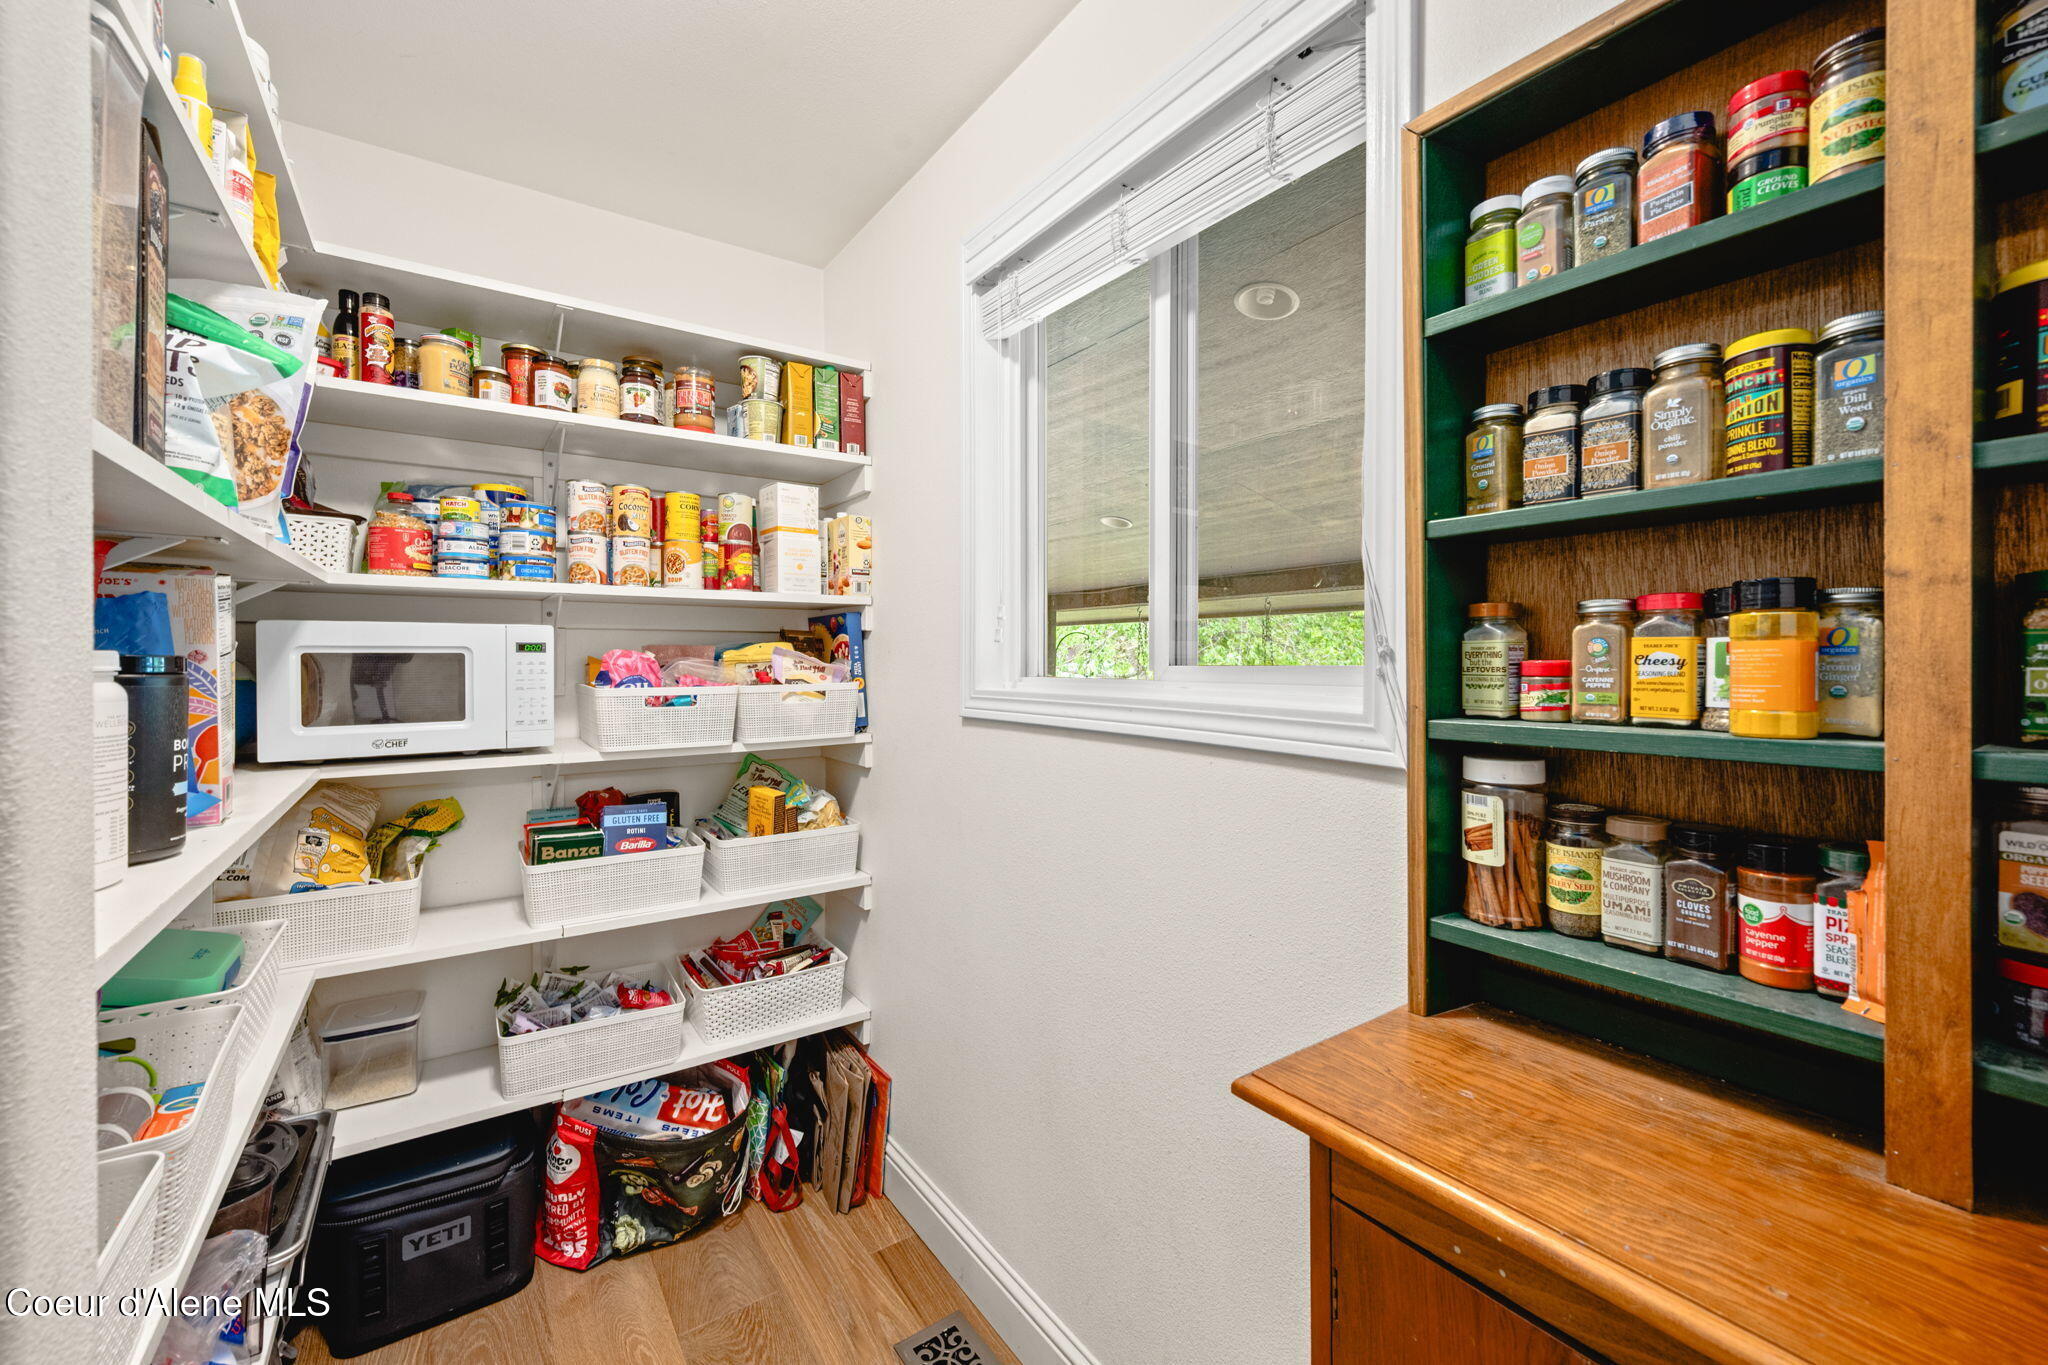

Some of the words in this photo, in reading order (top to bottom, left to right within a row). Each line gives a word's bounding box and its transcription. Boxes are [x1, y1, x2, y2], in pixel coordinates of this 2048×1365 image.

[1755, 110, 1794, 130] Pumpkin
[1769, 120, 1792, 132] Spice
[1757, 173, 1798, 187] GROUND
[1757, 179, 1799, 195] CLOVES
[1583, 213, 1617, 229] Parsley
[1836, 374, 1874, 388] organics
[1844, 392, 1868, 405] Dill
[1654, 406, 1693, 421] Simply
[1839, 402, 1873, 415] Weed
[1664, 434, 1681, 443] chili
[1747, 437, 1777, 452] BLEND
[1658, 440, 1688, 452] powder
[1471, 461, 1496, 471] Ground
[1534, 462, 1556, 470] Onion
[1591, 455, 1620, 465] Powder
[1472, 469, 1494, 479] Cumin
[1531, 467, 1559, 477] Powder
[618, 502, 649, 513] COCONUT
[680, 503, 700, 511] CORN
[175, 578, 213, 590] NATURALLY
[179, 591, 213, 604] FLAVORED
[172, 604, 189, 617] WITH
[192, 604, 214, 617] OTHER
[184, 618, 213, 630] NATURAL
[1464, 650, 1502, 660] EVERYTHING
[1634, 654, 1687, 670] Cheesy
[1819, 663, 1861, 671] Ground
[1820, 672, 1858, 682] Ginger
[385, 740, 408, 748] CHEF
[612, 815, 641, 825] GLUTEN
[644, 813, 660, 823] FREE
[620, 839, 653, 850] Barilla
[541, 845, 600, 860] Banza
[1563, 850, 1600, 860] ISLANDS
[1603, 870, 1651, 886] MUSHROOM
[1574, 882, 1595, 892] SEED
[1610, 882, 1651, 896] COMPANY
[1678, 883, 1708, 893] PRIVATE
[1603, 893, 1650, 907] MULTIPURPOSE
[1676, 899, 1711, 914] CLOVES
[1603, 900, 1651, 917] UMAMI
[1744, 906, 1759, 916] food
[1604, 909, 1633, 919] SEASONING
[1633, 914, 1652, 923] BLEND
[1745, 928, 1786, 942] cayenne
[1745, 936, 1779, 950] pepper
[726, 1064, 741, 1077] PULL
[593, 1105, 641, 1124] ITEMS
[408, 1222, 467, 1251] YETI
